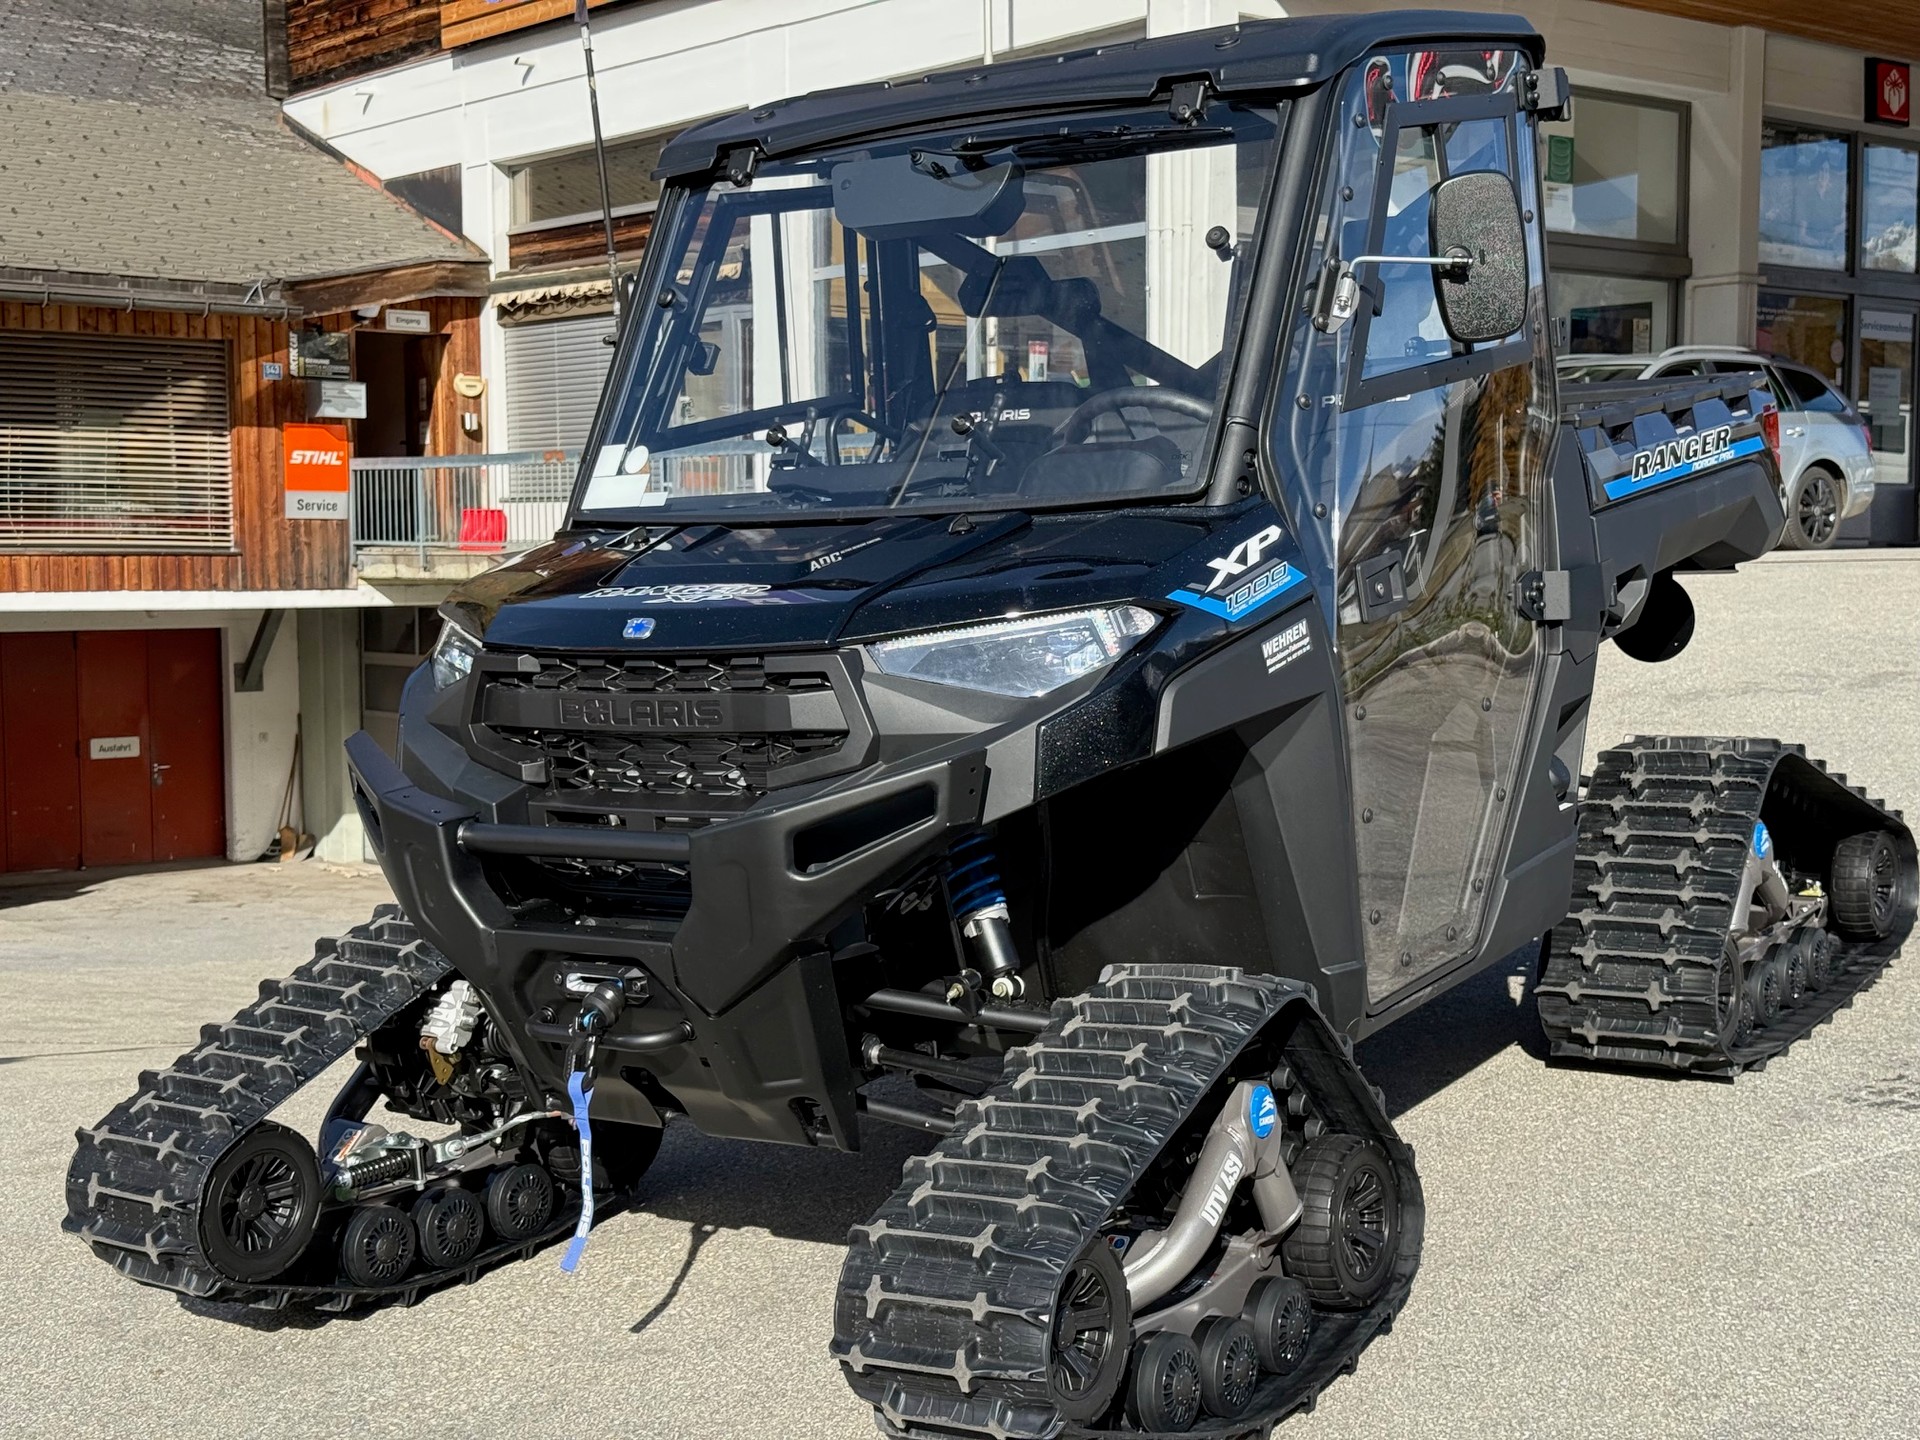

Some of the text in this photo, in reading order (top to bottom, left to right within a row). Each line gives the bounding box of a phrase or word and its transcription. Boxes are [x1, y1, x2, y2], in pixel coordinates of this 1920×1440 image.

[396, 316, 421, 326] Eingang
[289, 450, 343, 466] STIHL
[1631, 425, 1731, 483] RANGER
[297, 498, 338, 511] Service
[1204, 524, 1282, 594] XP
[1225, 560, 1289, 613] 1000
[1262, 620, 1308, 659] WEHREN
[559, 699, 724, 728] POLARIS
[577, 1138, 593, 1239] POLARIS
[1201, 1183, 1228, 1228] UTV
